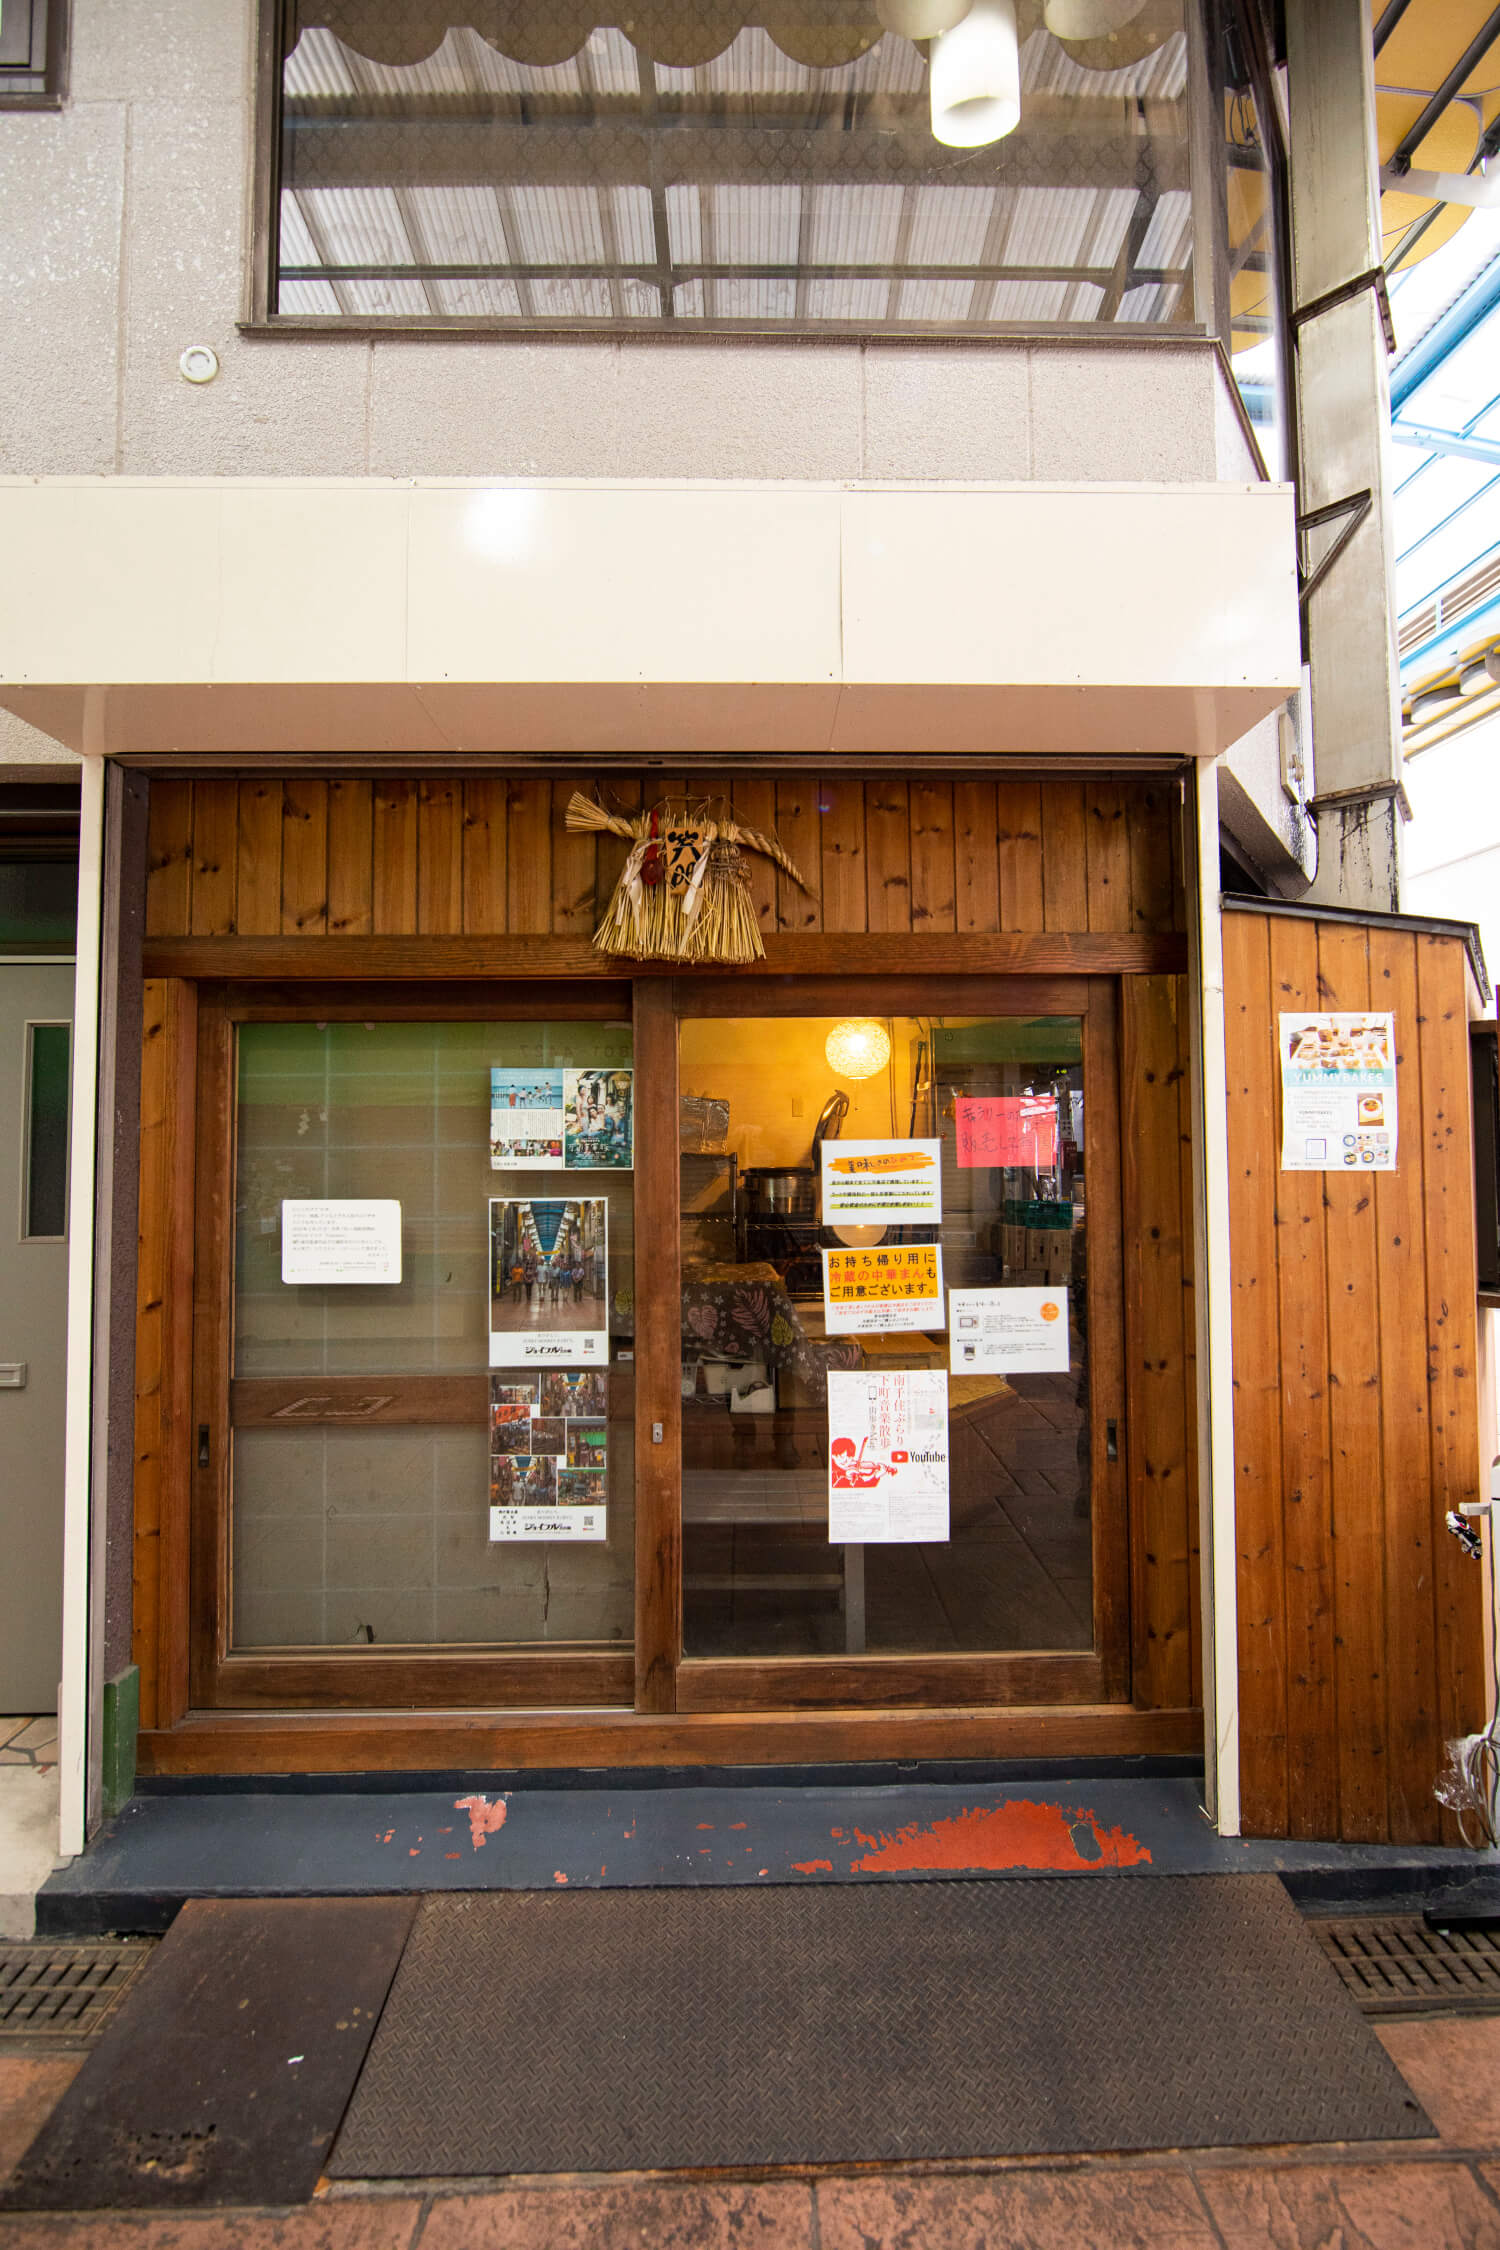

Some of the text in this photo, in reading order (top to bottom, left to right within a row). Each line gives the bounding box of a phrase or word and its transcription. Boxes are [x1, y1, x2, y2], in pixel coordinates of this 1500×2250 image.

[1295, 1072, 1384, 1082] YUMMYBAKES
[829, 1253, 936, 1268] お持ち帰り用に
[830, 1267, 936, 1283] 冷蔵の中華まんも
[830, 1282, 935, 1298] ご用意ございます。
[910, 1451, 946, 1463] YouTube
